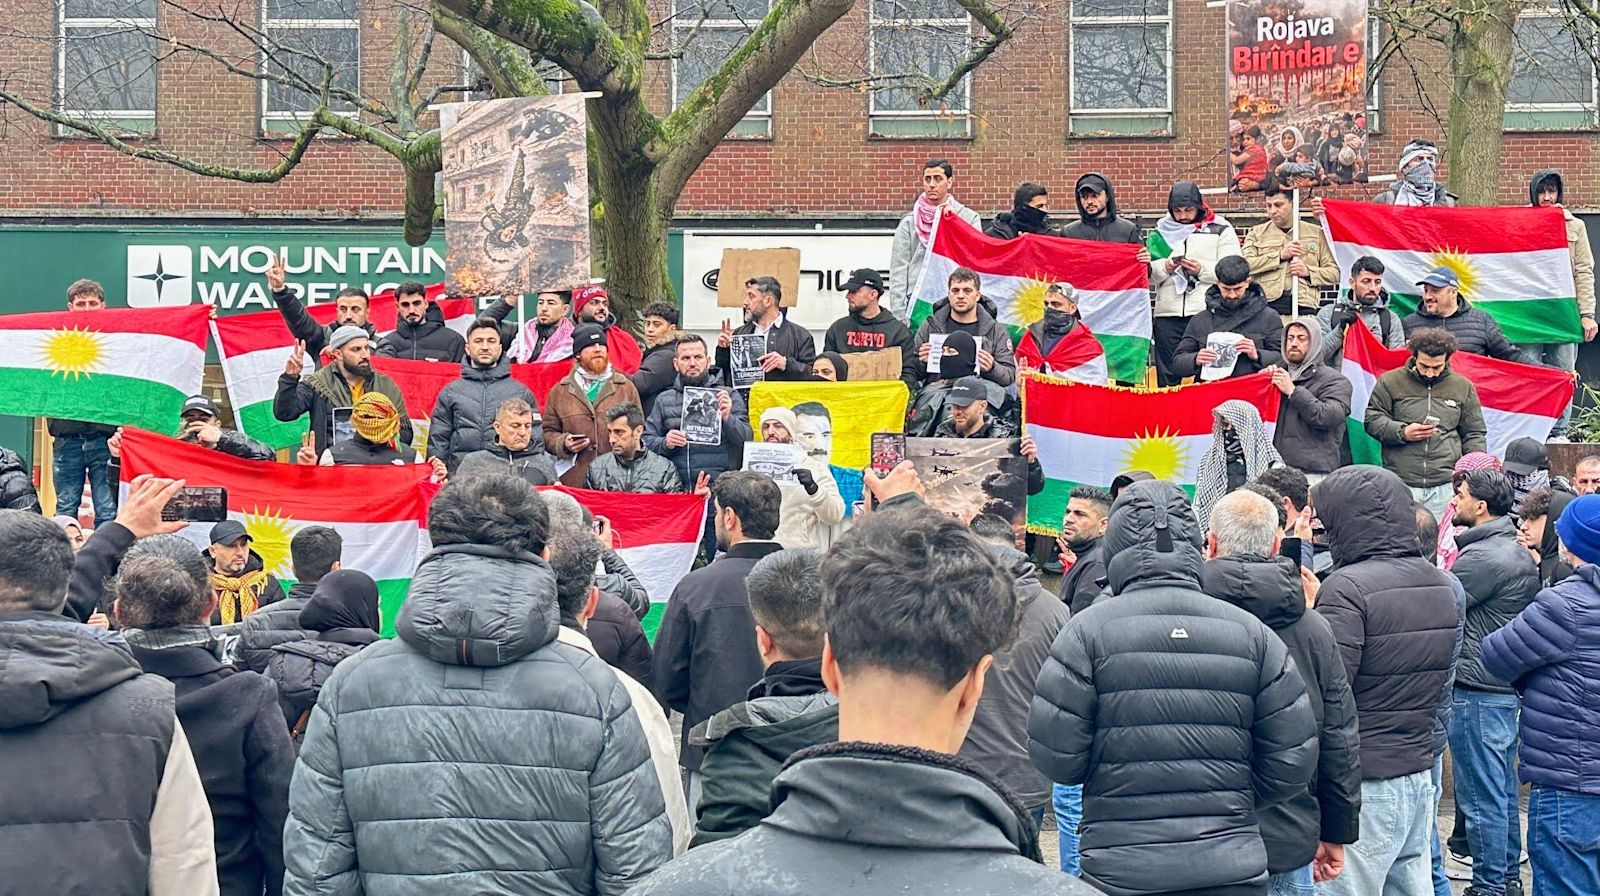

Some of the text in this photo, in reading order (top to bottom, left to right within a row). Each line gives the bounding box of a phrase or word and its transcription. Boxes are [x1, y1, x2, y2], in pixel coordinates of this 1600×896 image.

[1257, 16, 1334, 44] Rojava
[1233, 40, 1360, 73] Birîndar e
[200, 245, 445, 274] MOUNTAIN
